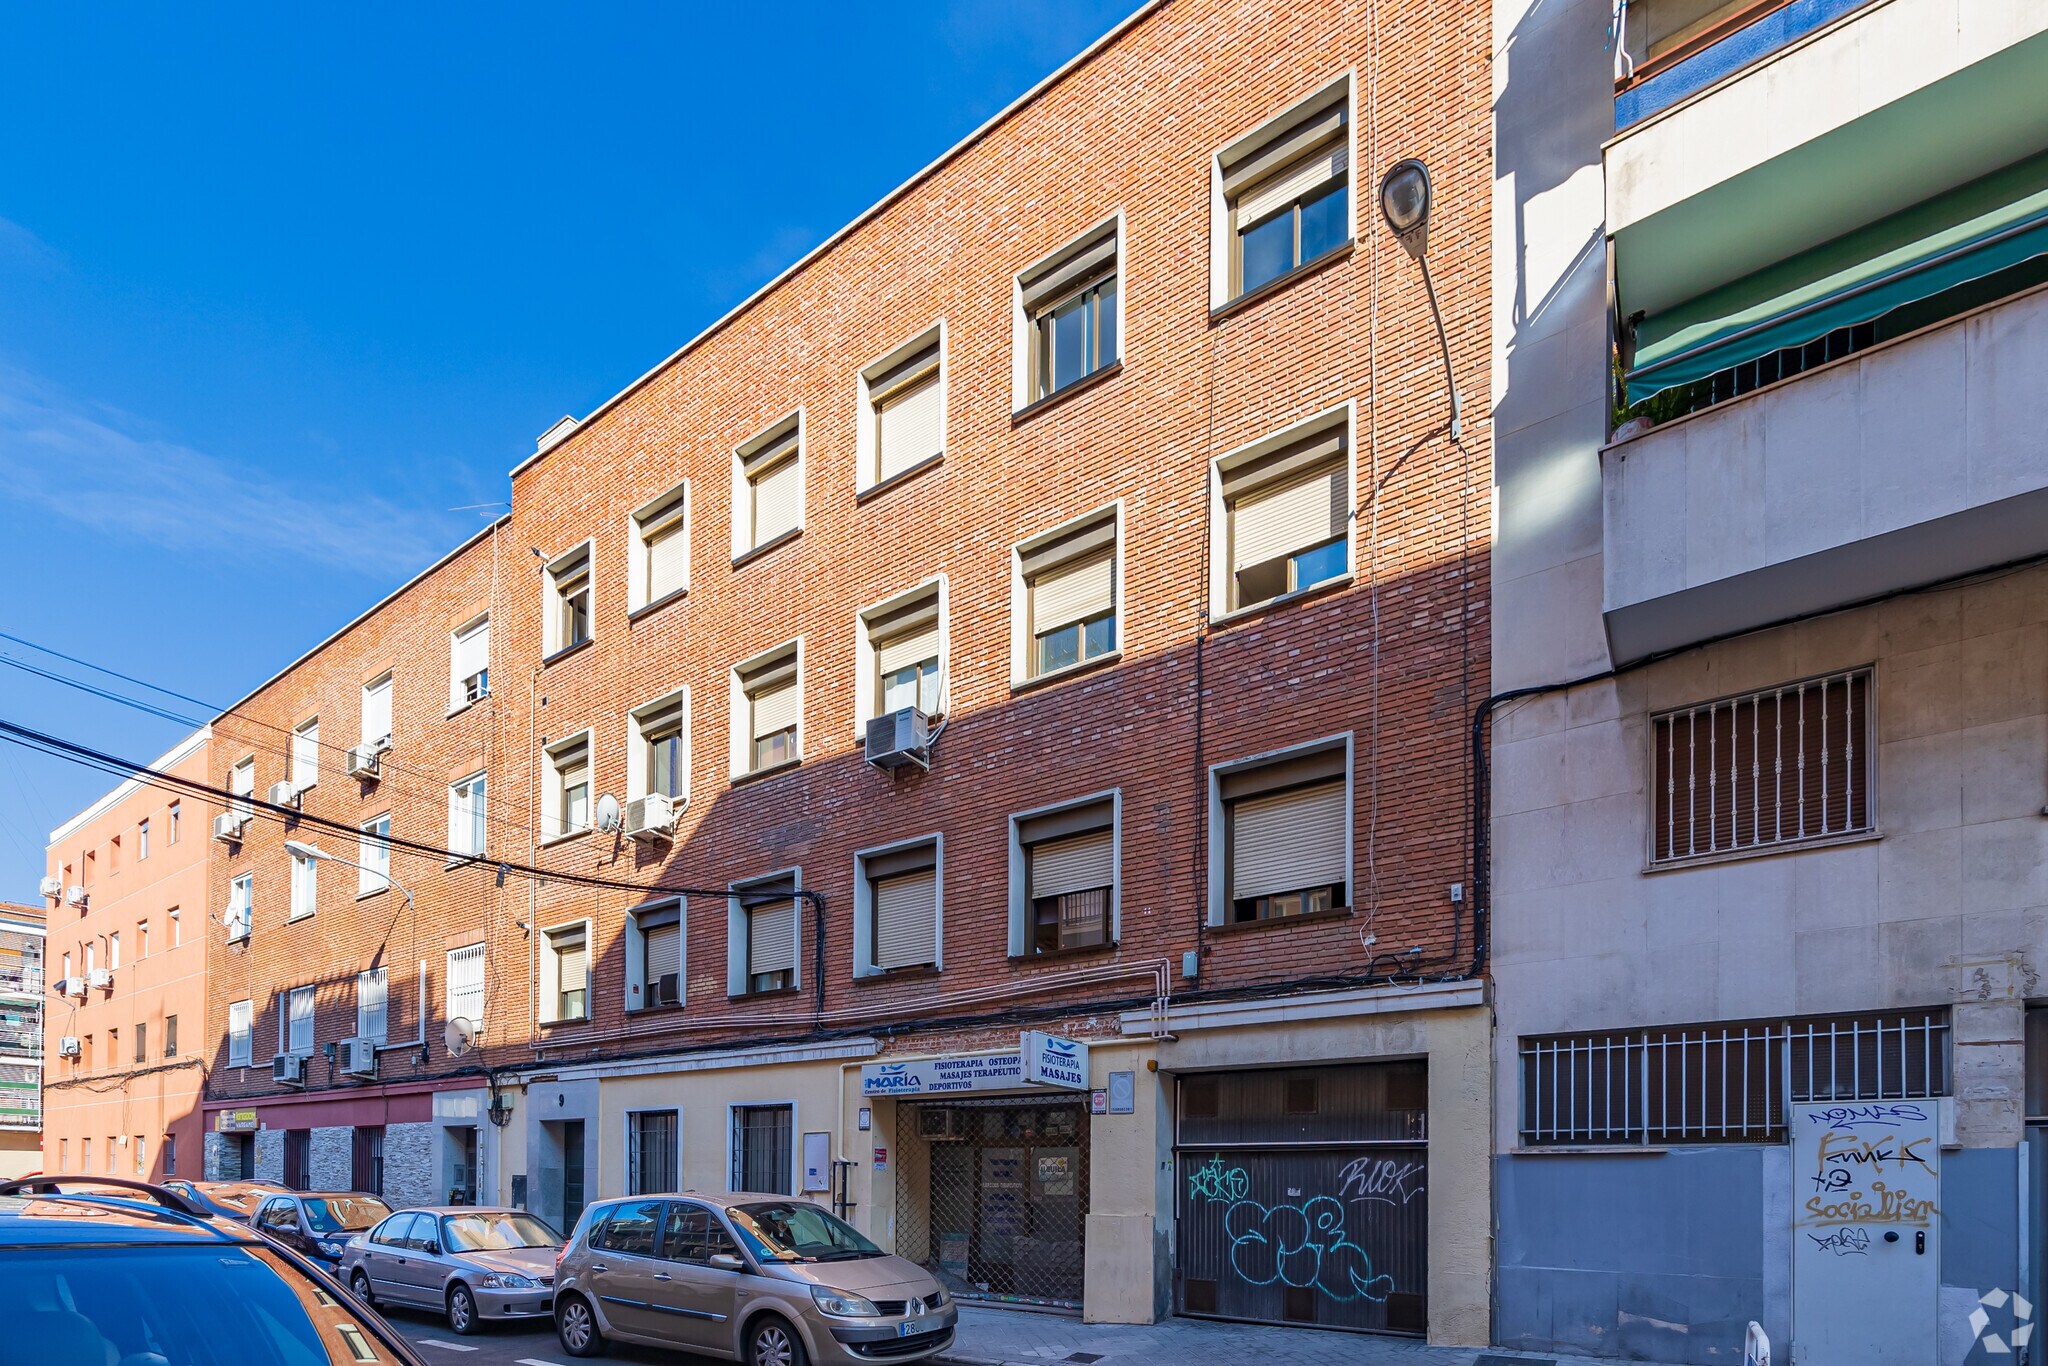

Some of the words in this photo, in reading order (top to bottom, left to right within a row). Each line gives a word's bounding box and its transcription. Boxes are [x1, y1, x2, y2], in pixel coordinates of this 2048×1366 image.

[934, 1059, 983, 1070] FISIOTERAPIA
[1042, 1053, 1080, 1070] FISIOTERAPIA
[940, 1070, 972, 1080] MASAJES
[1040, 1066, 1082, 1084] MASAJES
[928, 1081, 972, 1091] DEPORTIVOS
[559, 1094, 565, 1107] 9
